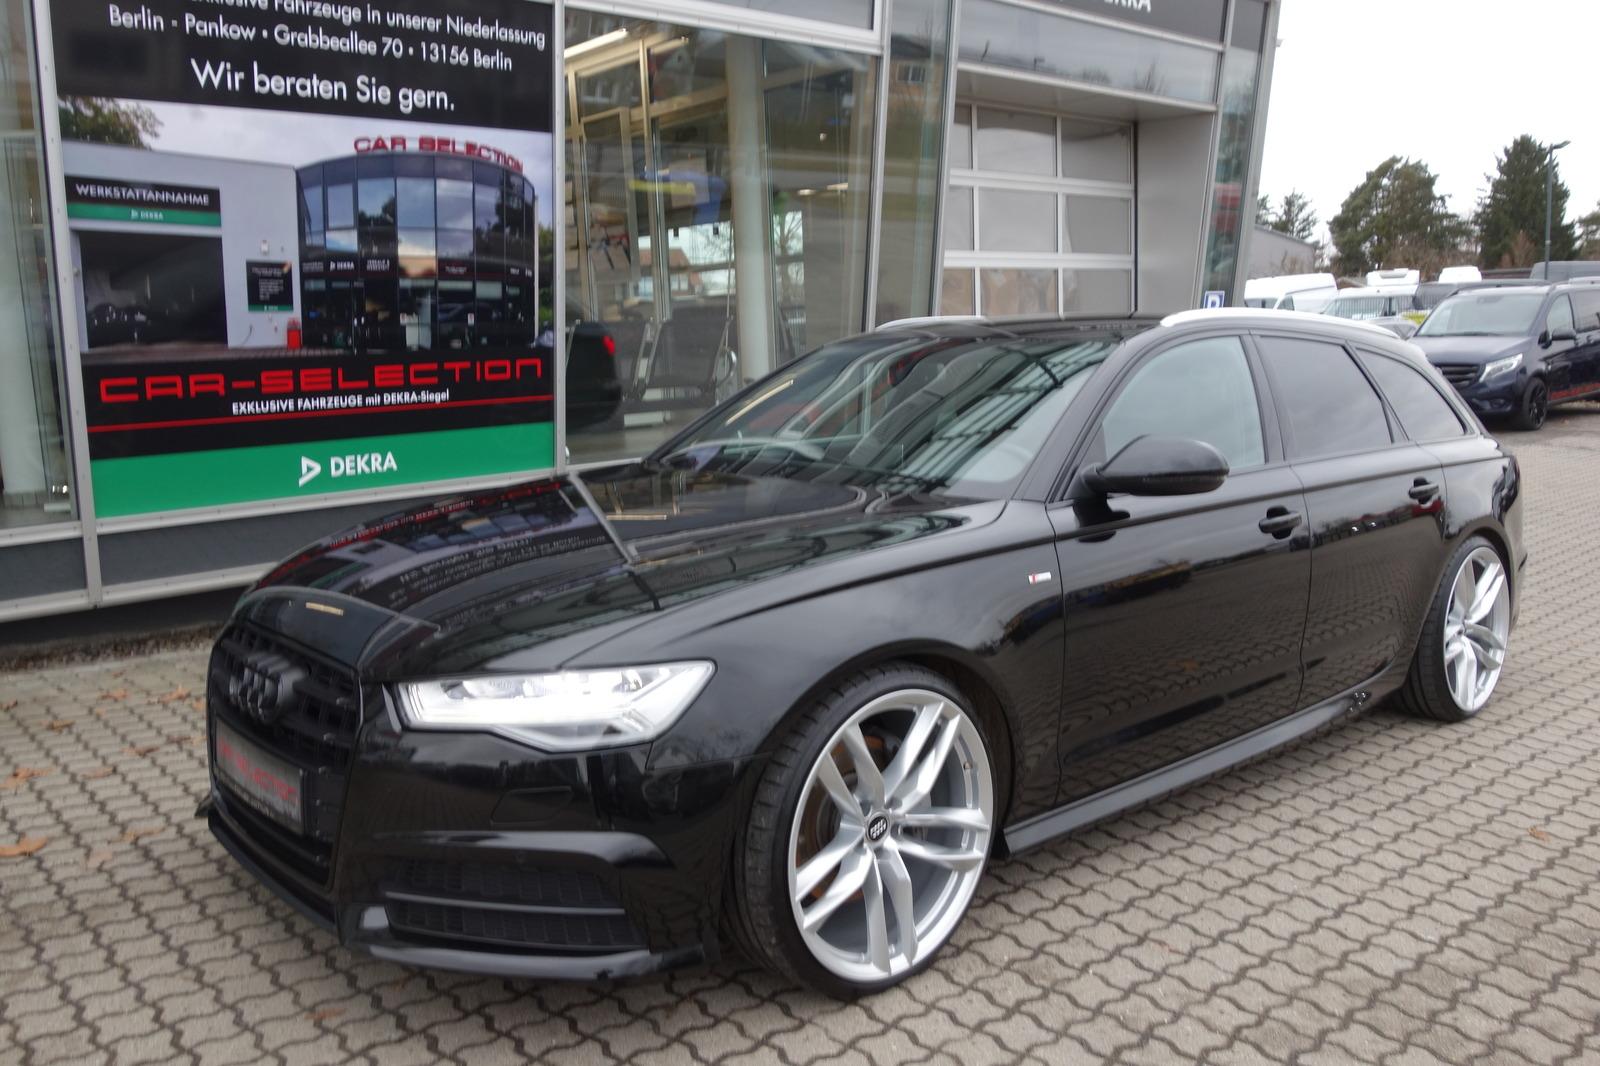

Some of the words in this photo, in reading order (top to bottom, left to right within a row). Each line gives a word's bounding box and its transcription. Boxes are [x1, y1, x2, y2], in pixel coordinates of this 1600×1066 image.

[109, 3, 164, 32] Berlin
[184, 12, 256, 41] Pankow
[274, 23, 377, 55] Grabbeallee
[381, 36, 403, 59] 70
[420, 41, 469, 66] 13156
[473, 47, 512, 72] Berlin
[274, 0, 361, 26] Fahrzeuge
[367, 3, 381, 25] in
[386, 12, 442, 32] unserer
[446, 14, 546, 51] Niederlassung
[190, 58, 245, 92] Wir
[253, 60, 347, 101] beraten
[356, 74, 391, 105] Sie
[398, 87, 455, 114] gern.
[353, 135, 407, 153] CAR
[418, 135, 524, 174] SELECTION
[75, 183, 209, 206] WERKSTATTANNAHME
[100, 358, 542, 403] CAR-SELECTION
[232, 399, 294, 415] EXKLUSIVE
[297, 394, 363, 411] FAHRZEUGE
[365, 394, 381, 407] mit
[383, 388, 450, 404] DEKRA-Siegel
[330, 451, 398, 477] DEKRA
